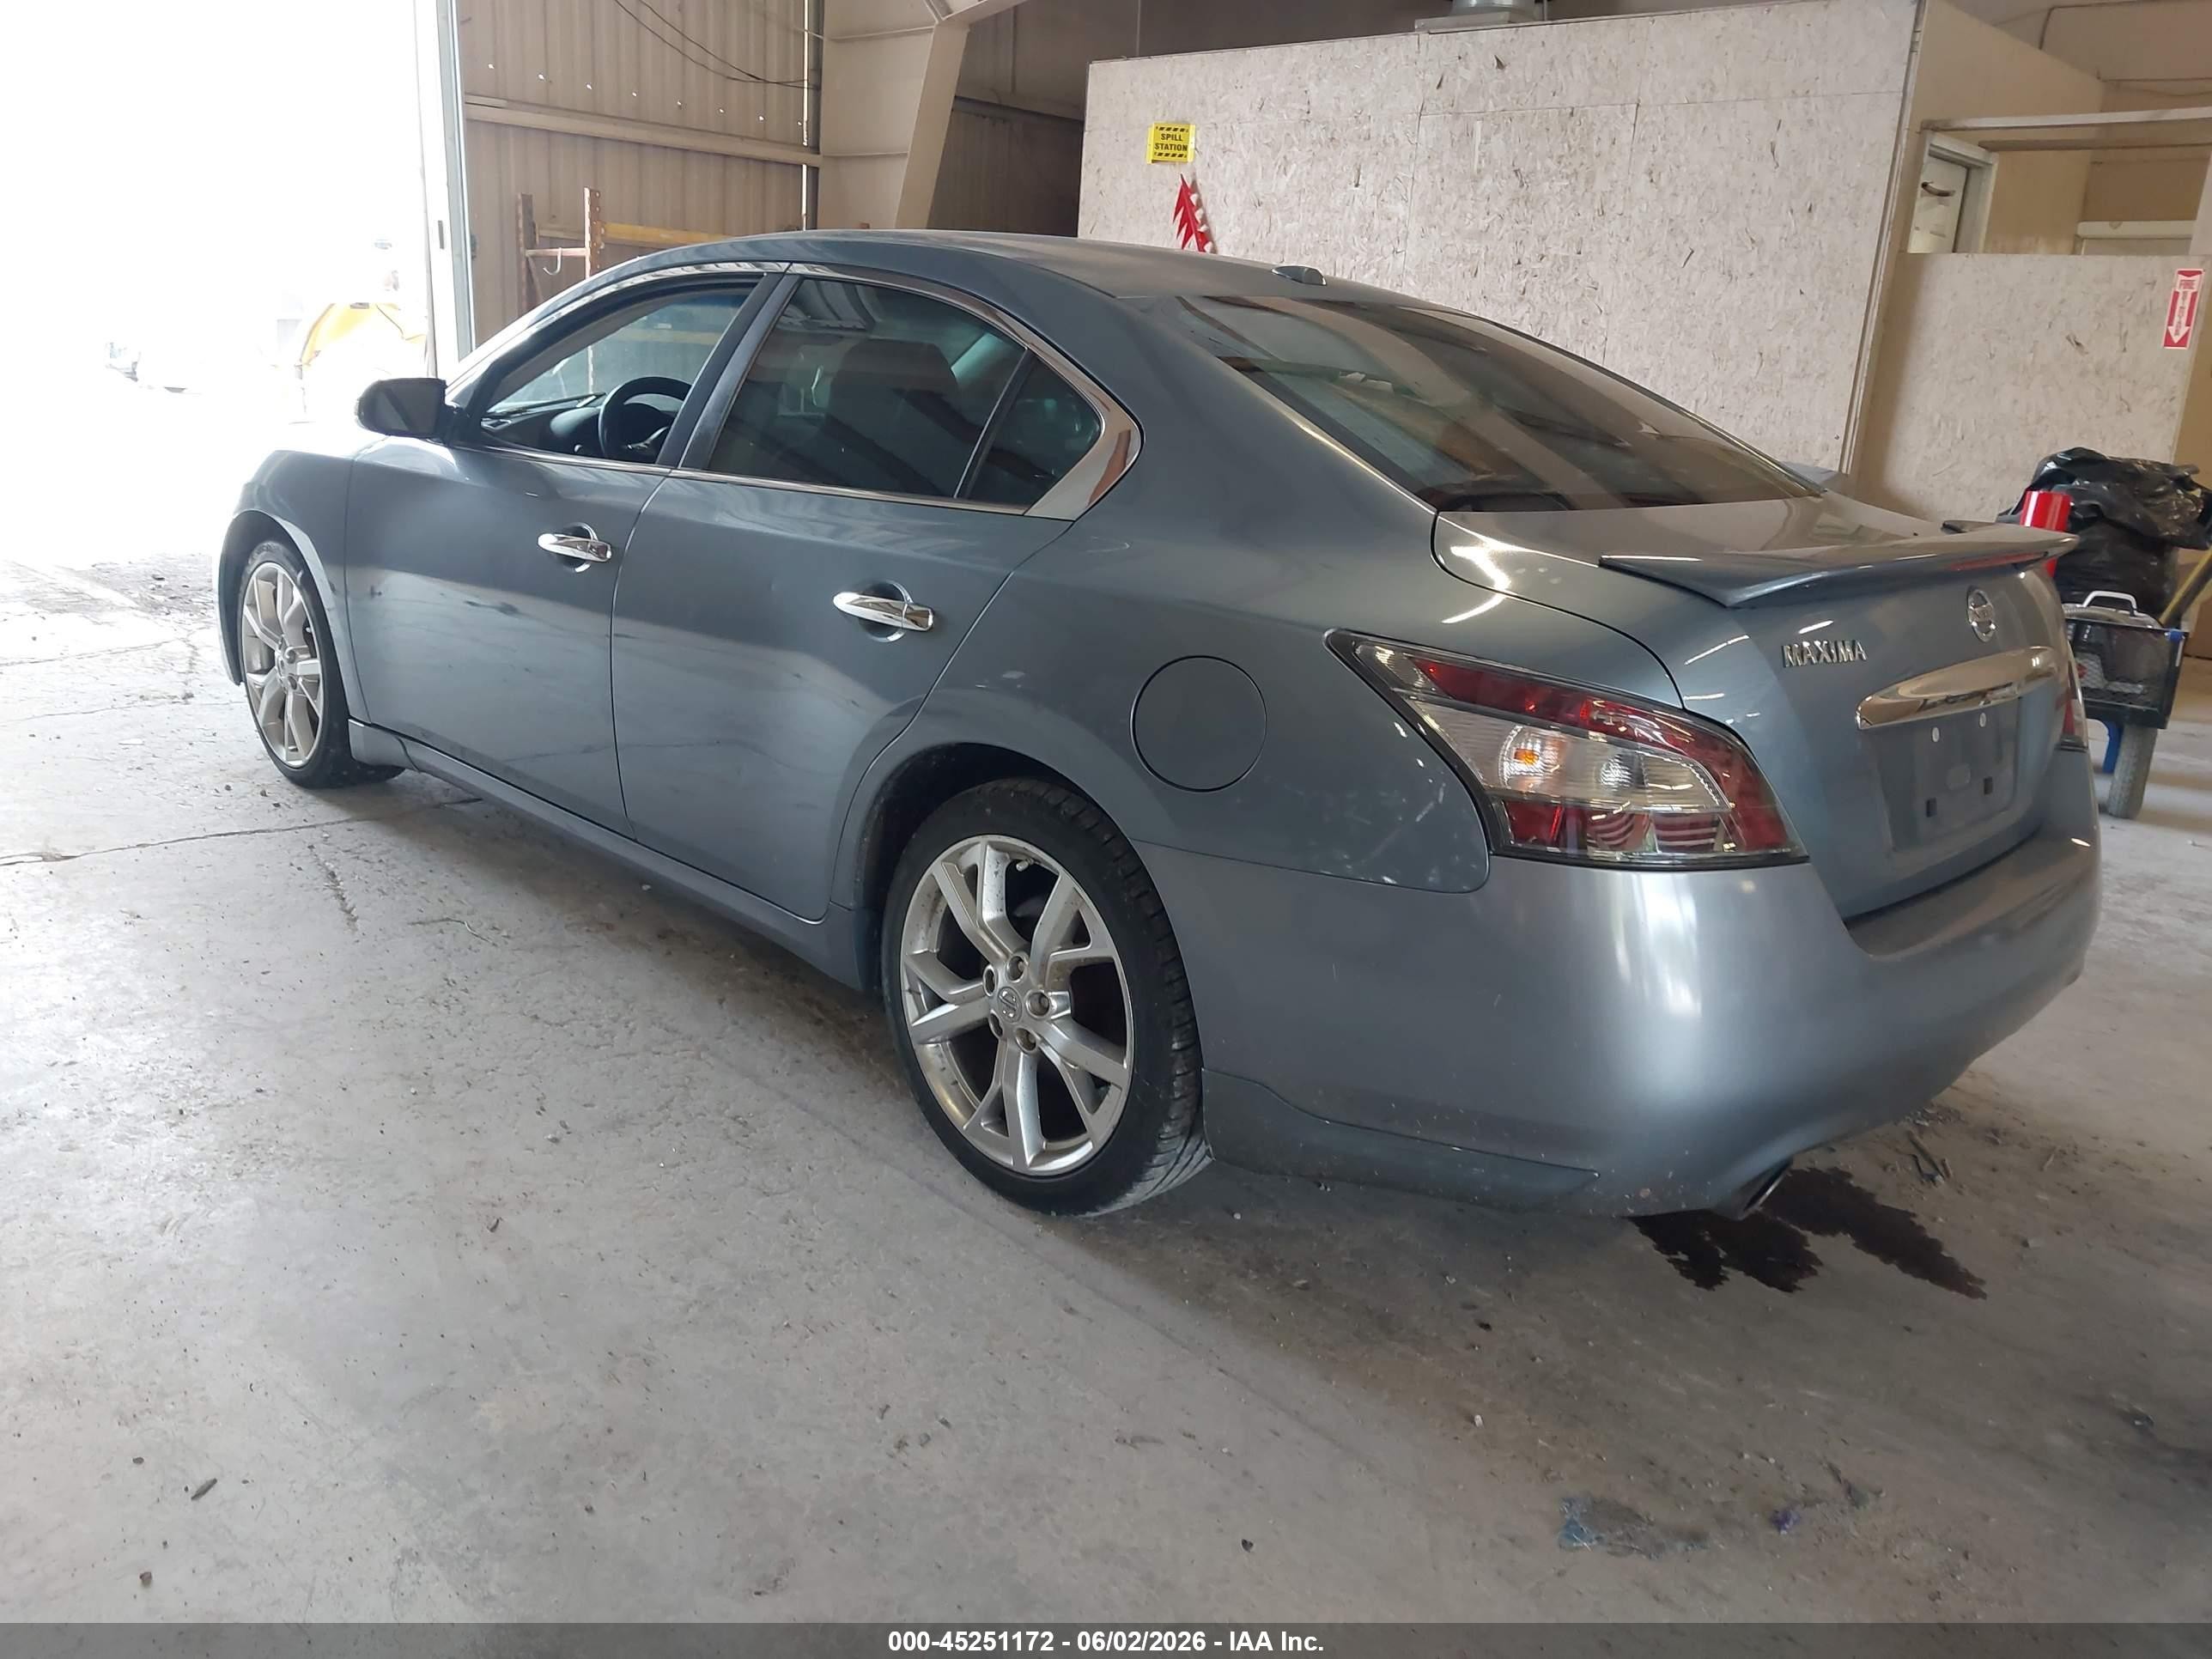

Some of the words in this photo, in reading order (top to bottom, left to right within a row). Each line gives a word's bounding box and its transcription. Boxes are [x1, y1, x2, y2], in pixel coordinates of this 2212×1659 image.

[1160, 133, 1183, 142] SPILL
[1154, 143, 1188, 152] STATION
[1782, 640, 1867, 667] MAXIMA
